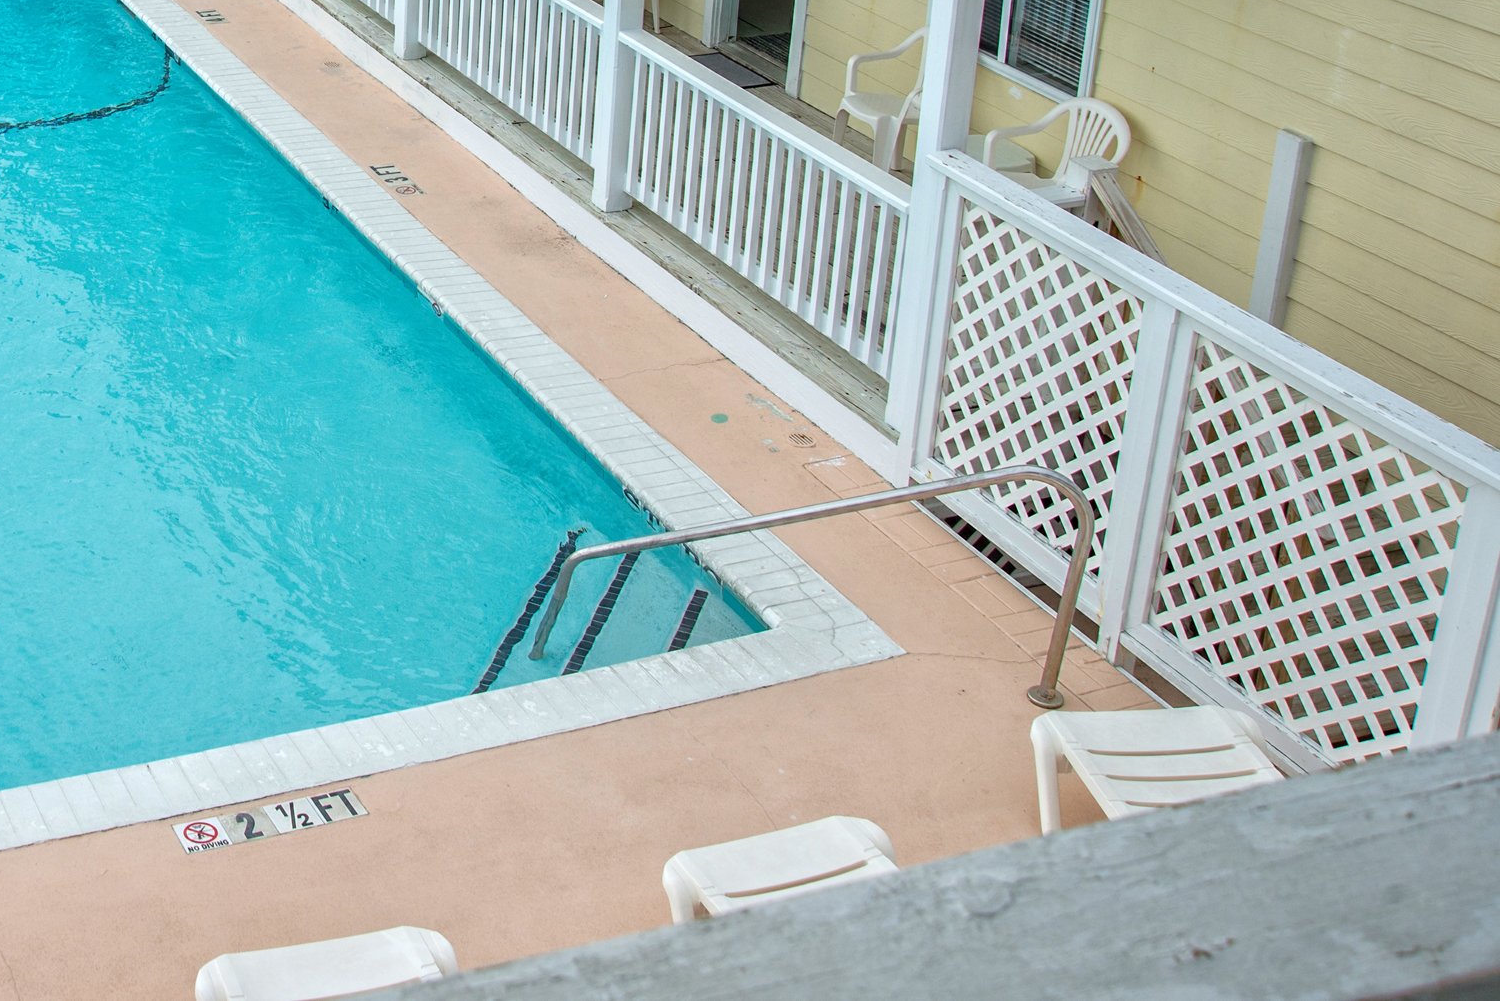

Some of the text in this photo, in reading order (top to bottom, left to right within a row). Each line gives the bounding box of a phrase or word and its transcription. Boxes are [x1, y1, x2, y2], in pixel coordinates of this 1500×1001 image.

[369, 165, 409, 184] 3 FT
[235, 812, 264, 840] 2
[311, 788, 359, 822] FT
[187, 839, 230, 854] NO DIVING
